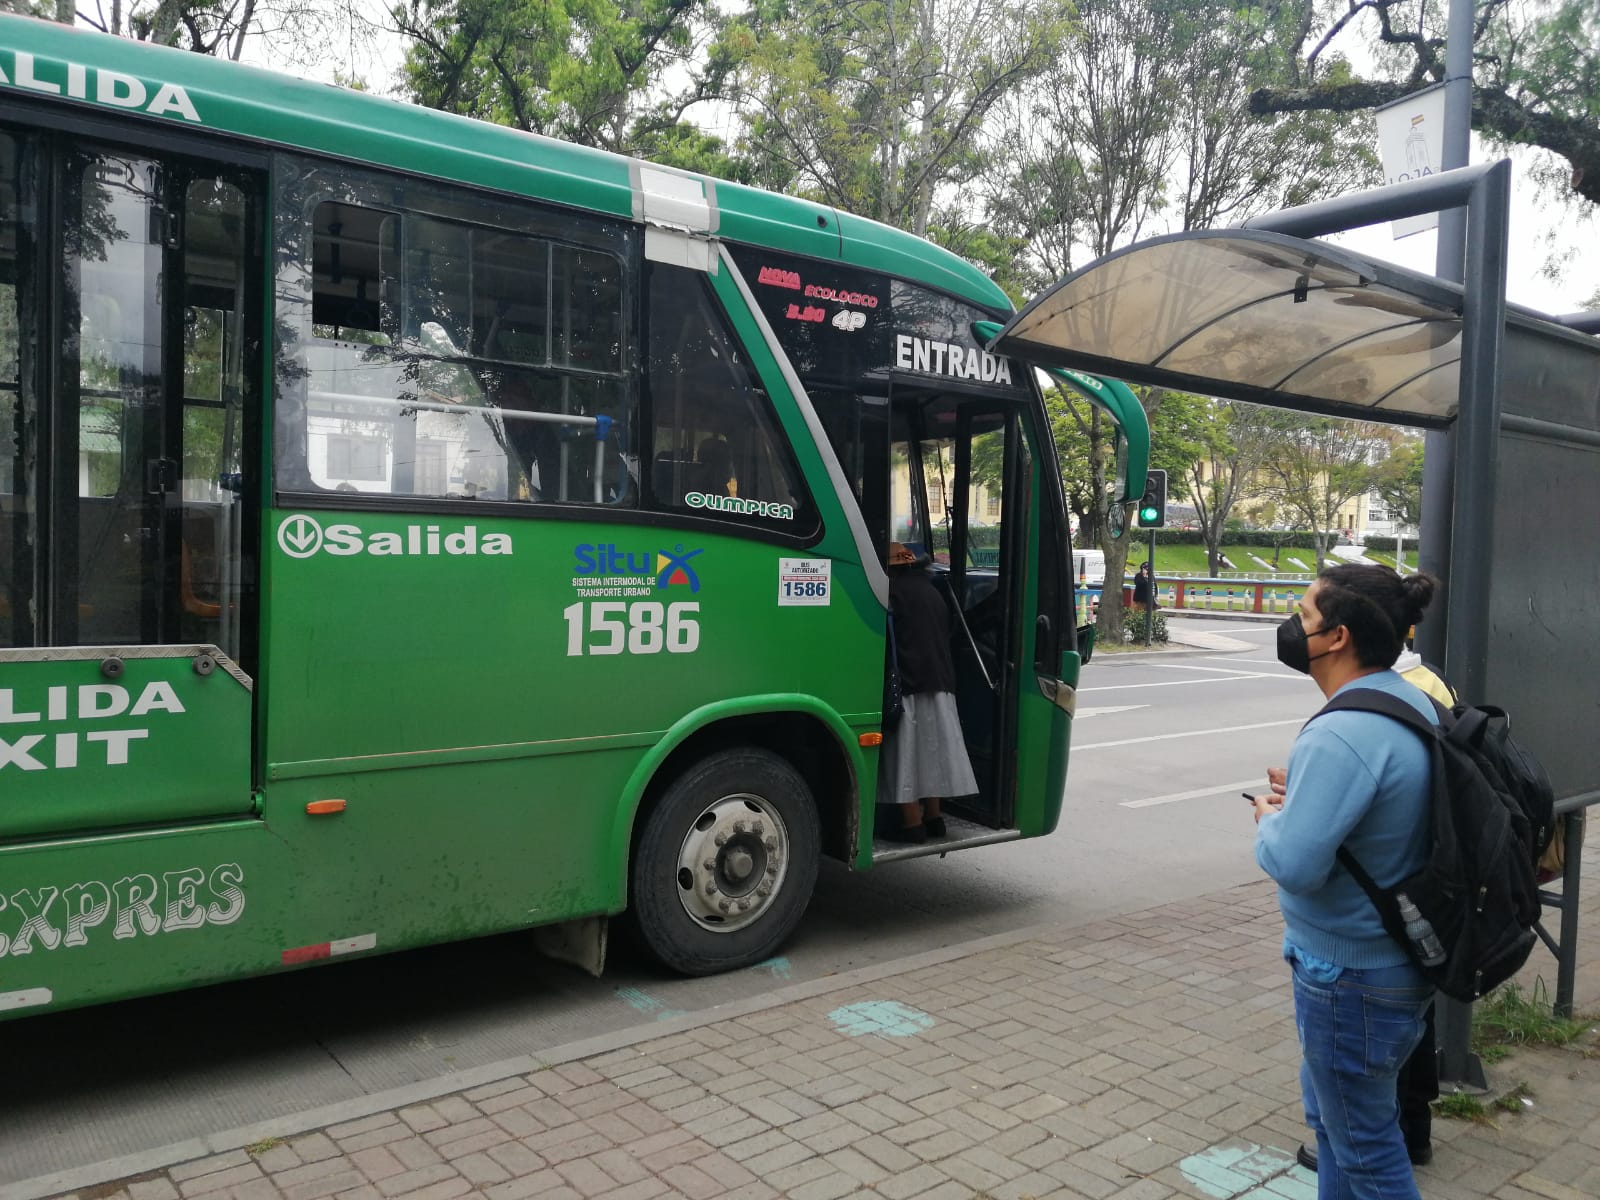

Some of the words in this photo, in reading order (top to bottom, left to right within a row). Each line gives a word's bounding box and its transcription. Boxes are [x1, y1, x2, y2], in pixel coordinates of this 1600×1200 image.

[804, 284, 878, 308] ECOLOGICO
[832, 309, 867, 331] 4P
[896, 334, 1012, 384] ENTRADA
[684, 491, 794, 520] OLIMPICA
[323, 524, 513, 556] Salida
[572, 577, 602, 587] SISTEMA
[603, 577, 645, 586] INTERMODAL
[646, 576, 656, 586] DE
[576, 588, 622, 598] TRANSPORTE
[623, 587, 651, 597] URBANO
[783, 581, 827, 597] 1586
[563, 601, 700, 657] 1586
[0, 862, 246, 958] XPRES
